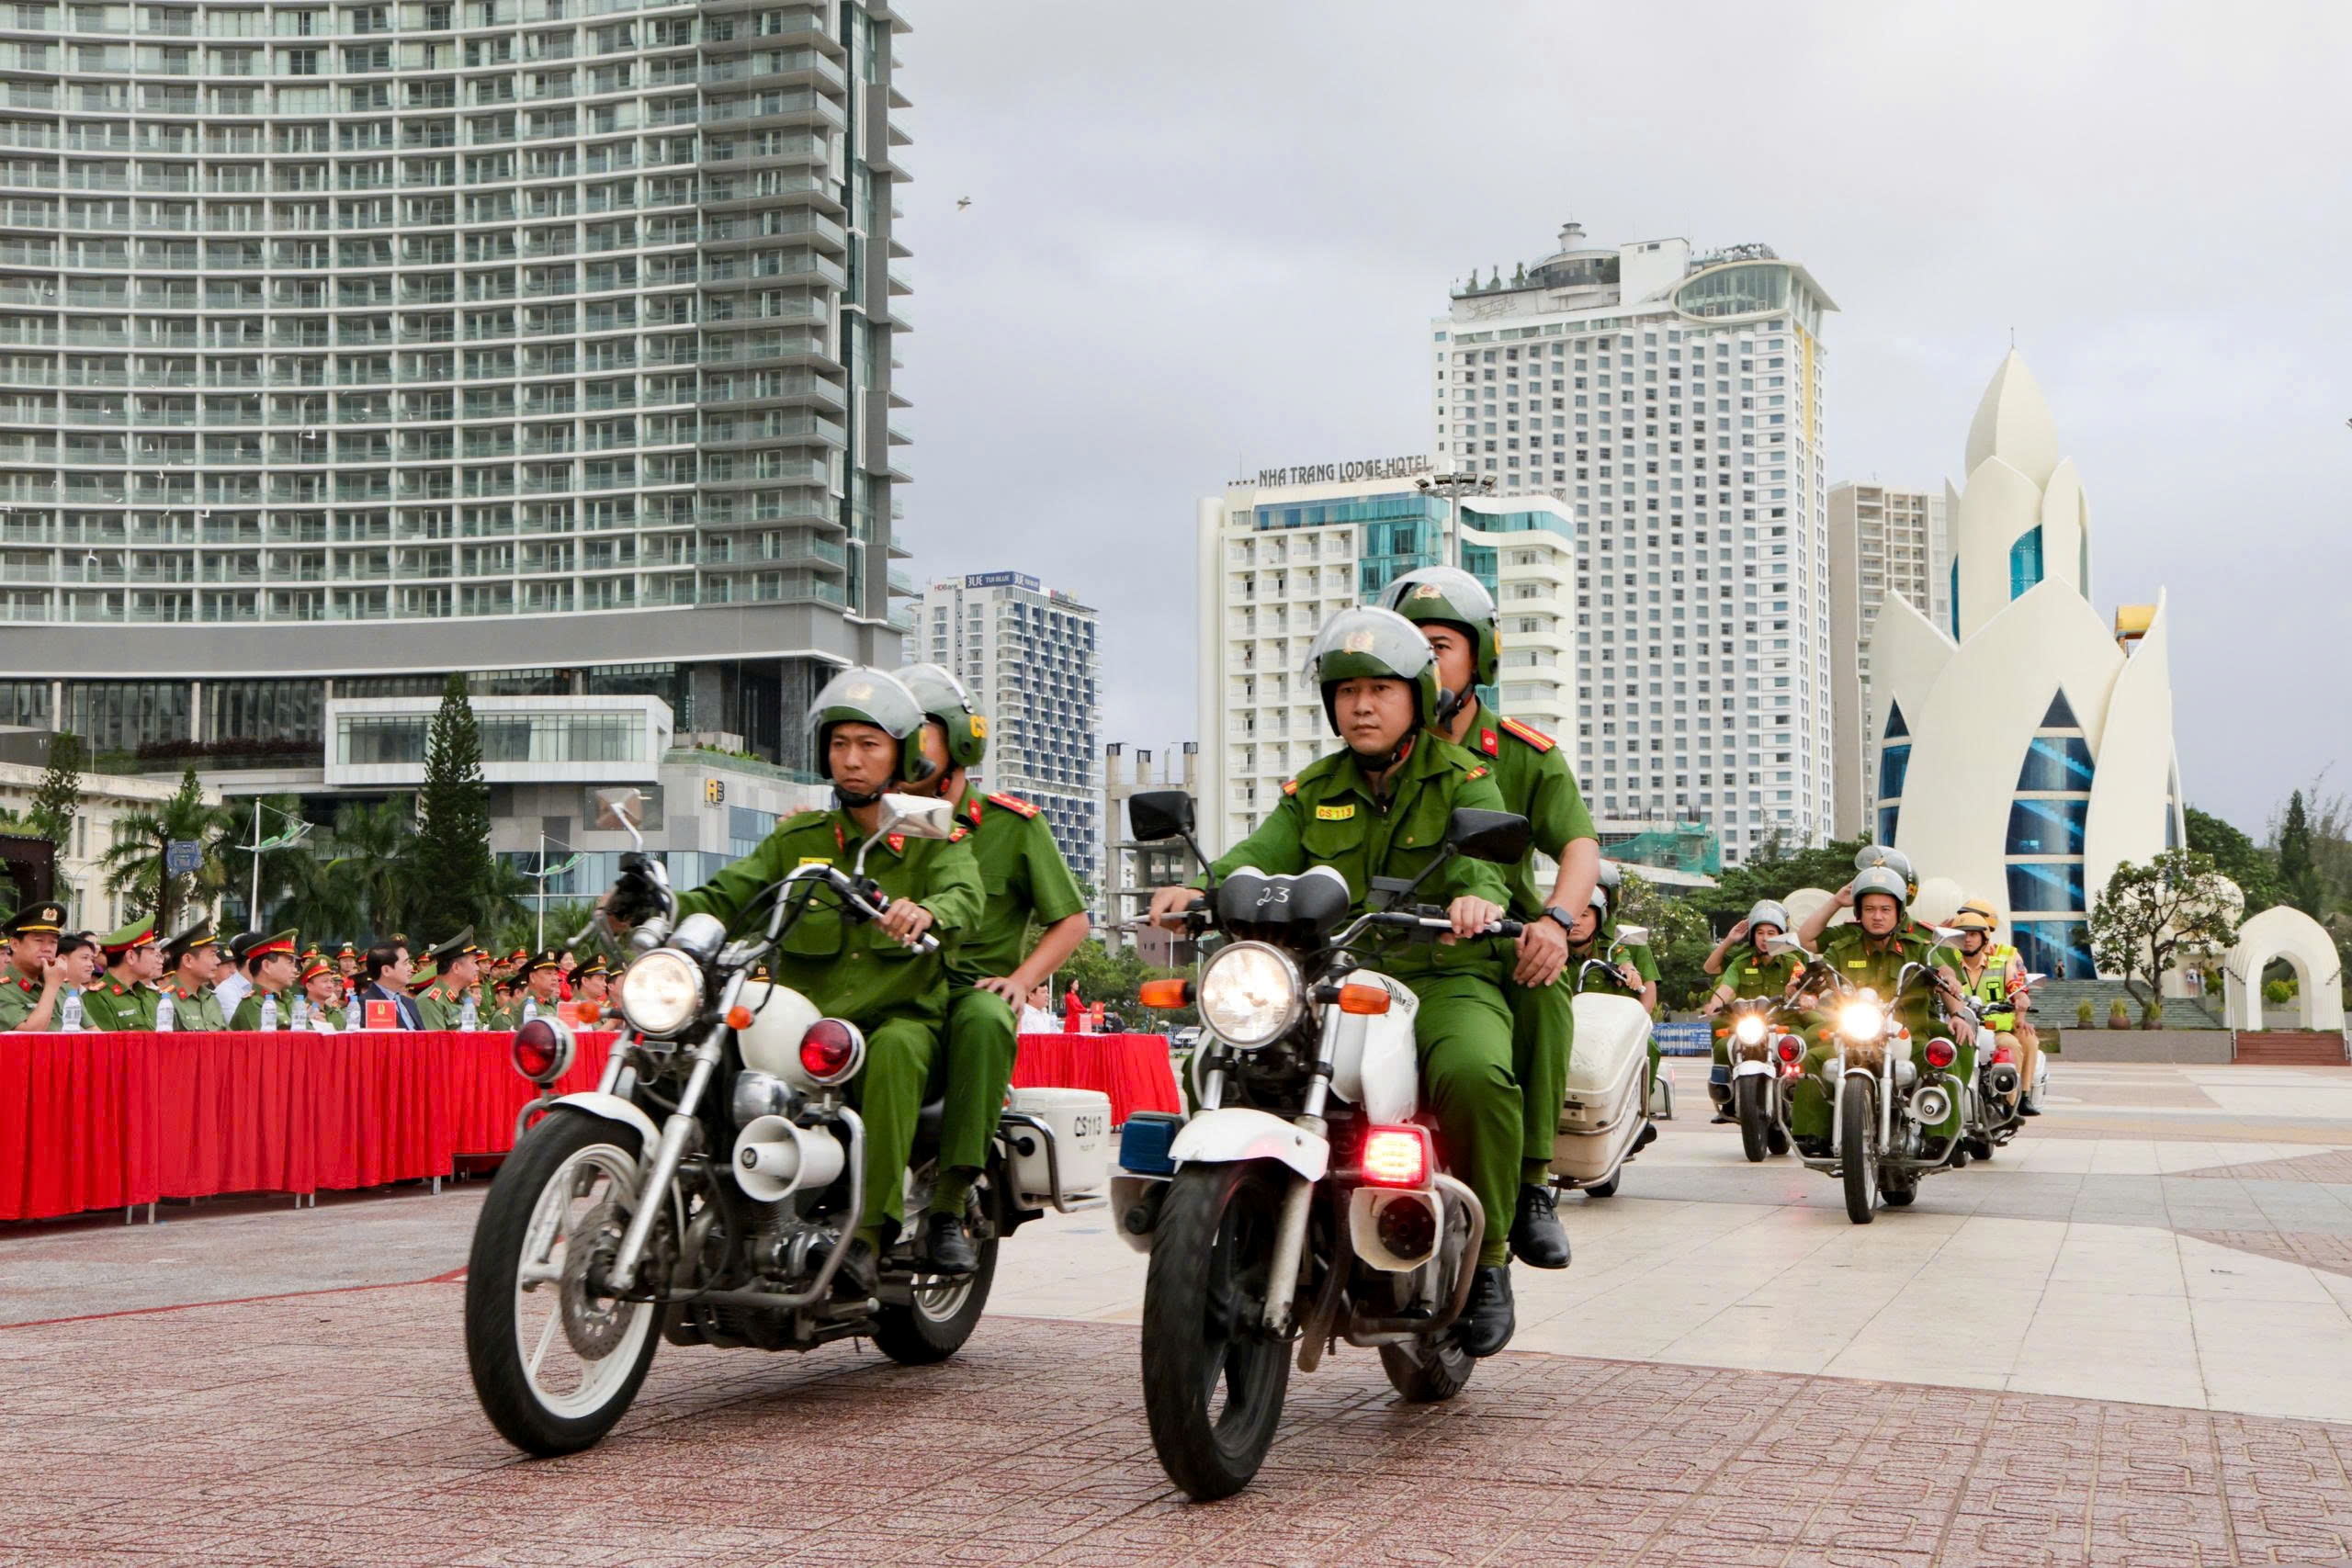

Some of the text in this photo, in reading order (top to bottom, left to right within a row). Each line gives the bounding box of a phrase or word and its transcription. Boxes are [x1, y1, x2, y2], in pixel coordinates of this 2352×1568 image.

[1259, 455, 1429, 488] NHA TRANG LODGE HOTEL
[1319, 807, 1352, 818] CS 113
[1256, 886, 1291, 906] 23
